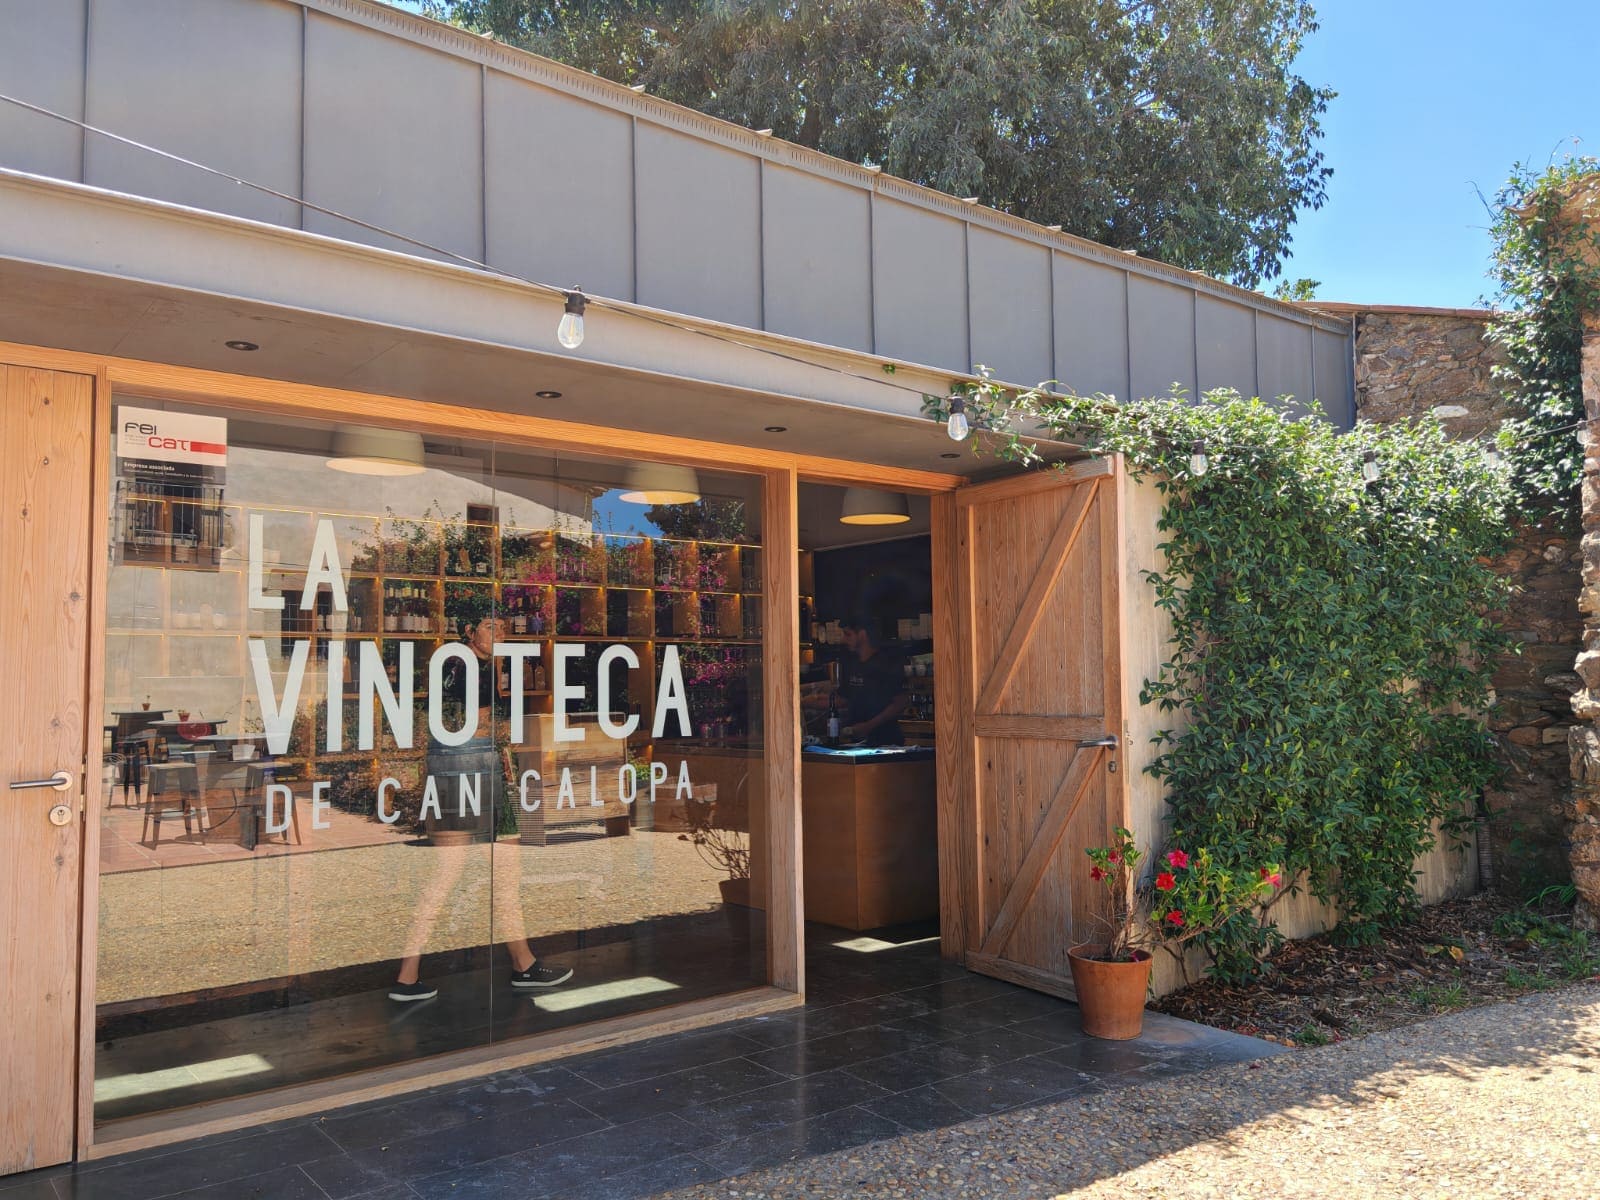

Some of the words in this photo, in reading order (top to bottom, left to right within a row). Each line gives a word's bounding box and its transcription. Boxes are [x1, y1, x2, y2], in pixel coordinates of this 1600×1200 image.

[124, 462, 148, 470] Empresa
[249, 514, 349, 610] LA
[249, 640, 692, 755] VINOTECA
[266, 781, 331, 833] DE
[378, 773, 481, 824] CAN
[520, 761, 692, 812] CALOPA
